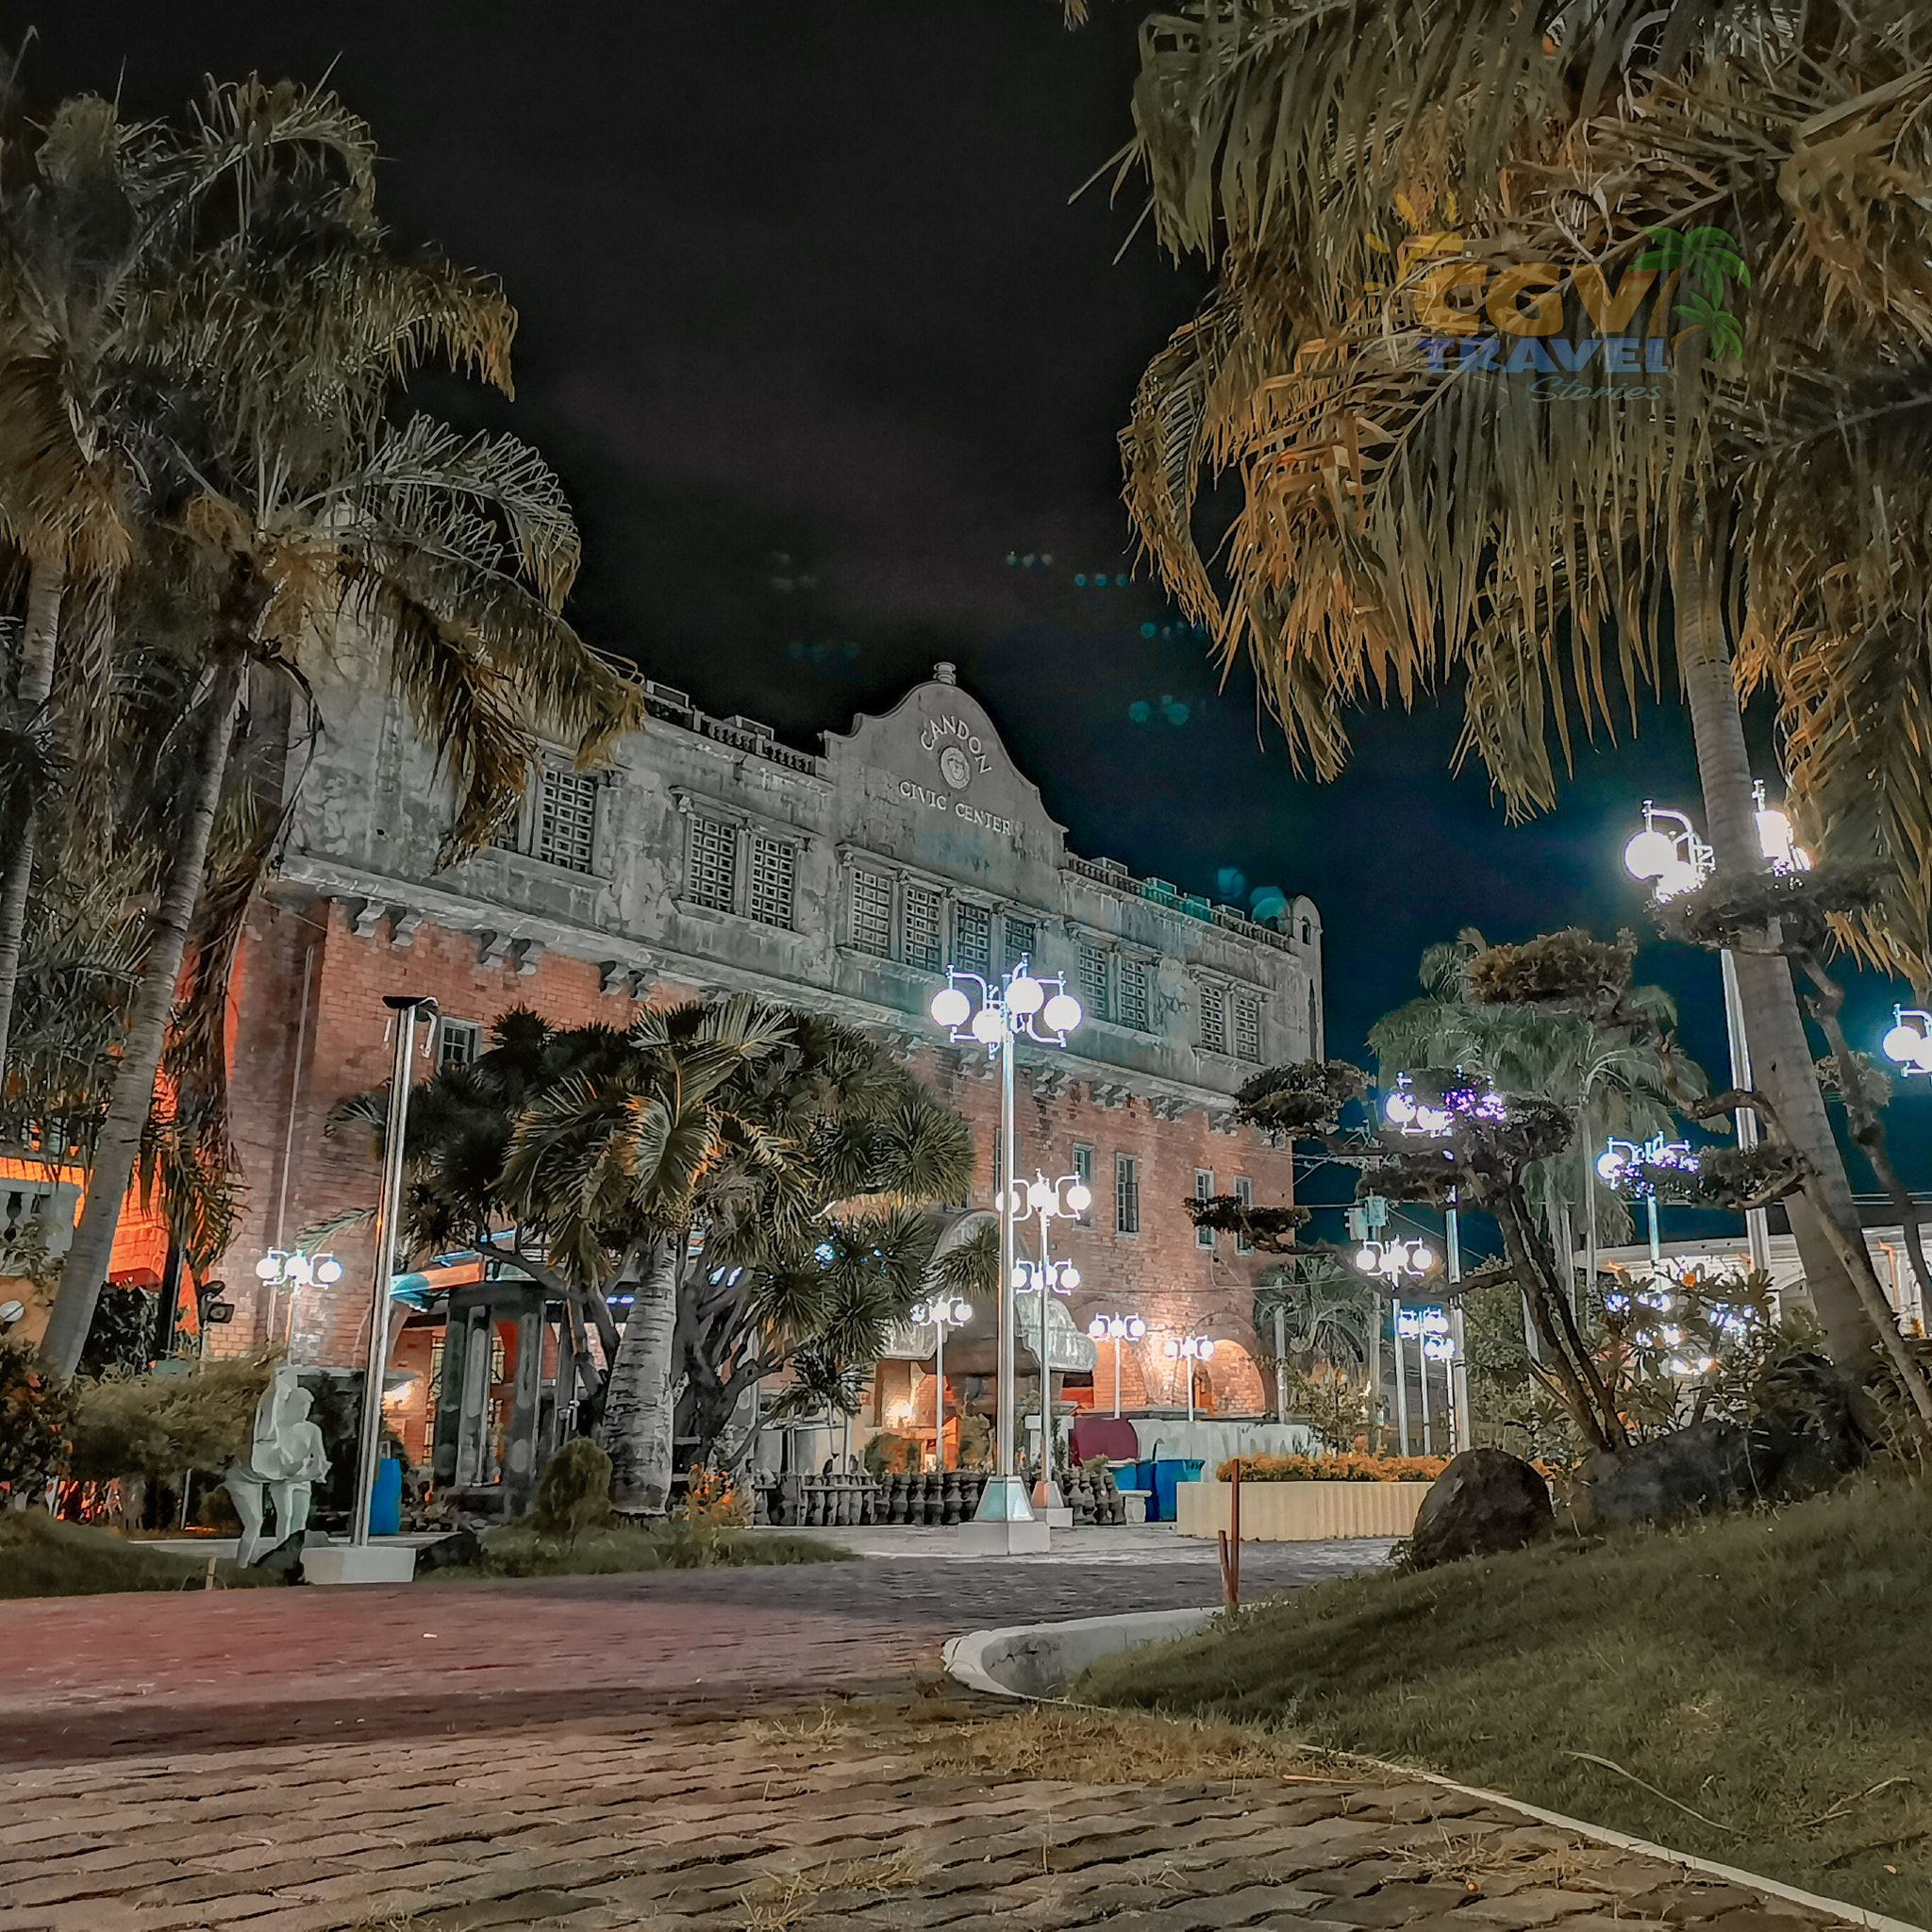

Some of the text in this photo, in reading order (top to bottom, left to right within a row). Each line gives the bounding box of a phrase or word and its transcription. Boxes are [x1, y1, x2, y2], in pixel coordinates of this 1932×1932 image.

[920, 714, 992, 774] CANDON
[899, 781, 1012, 836] CIVIC CENTER
